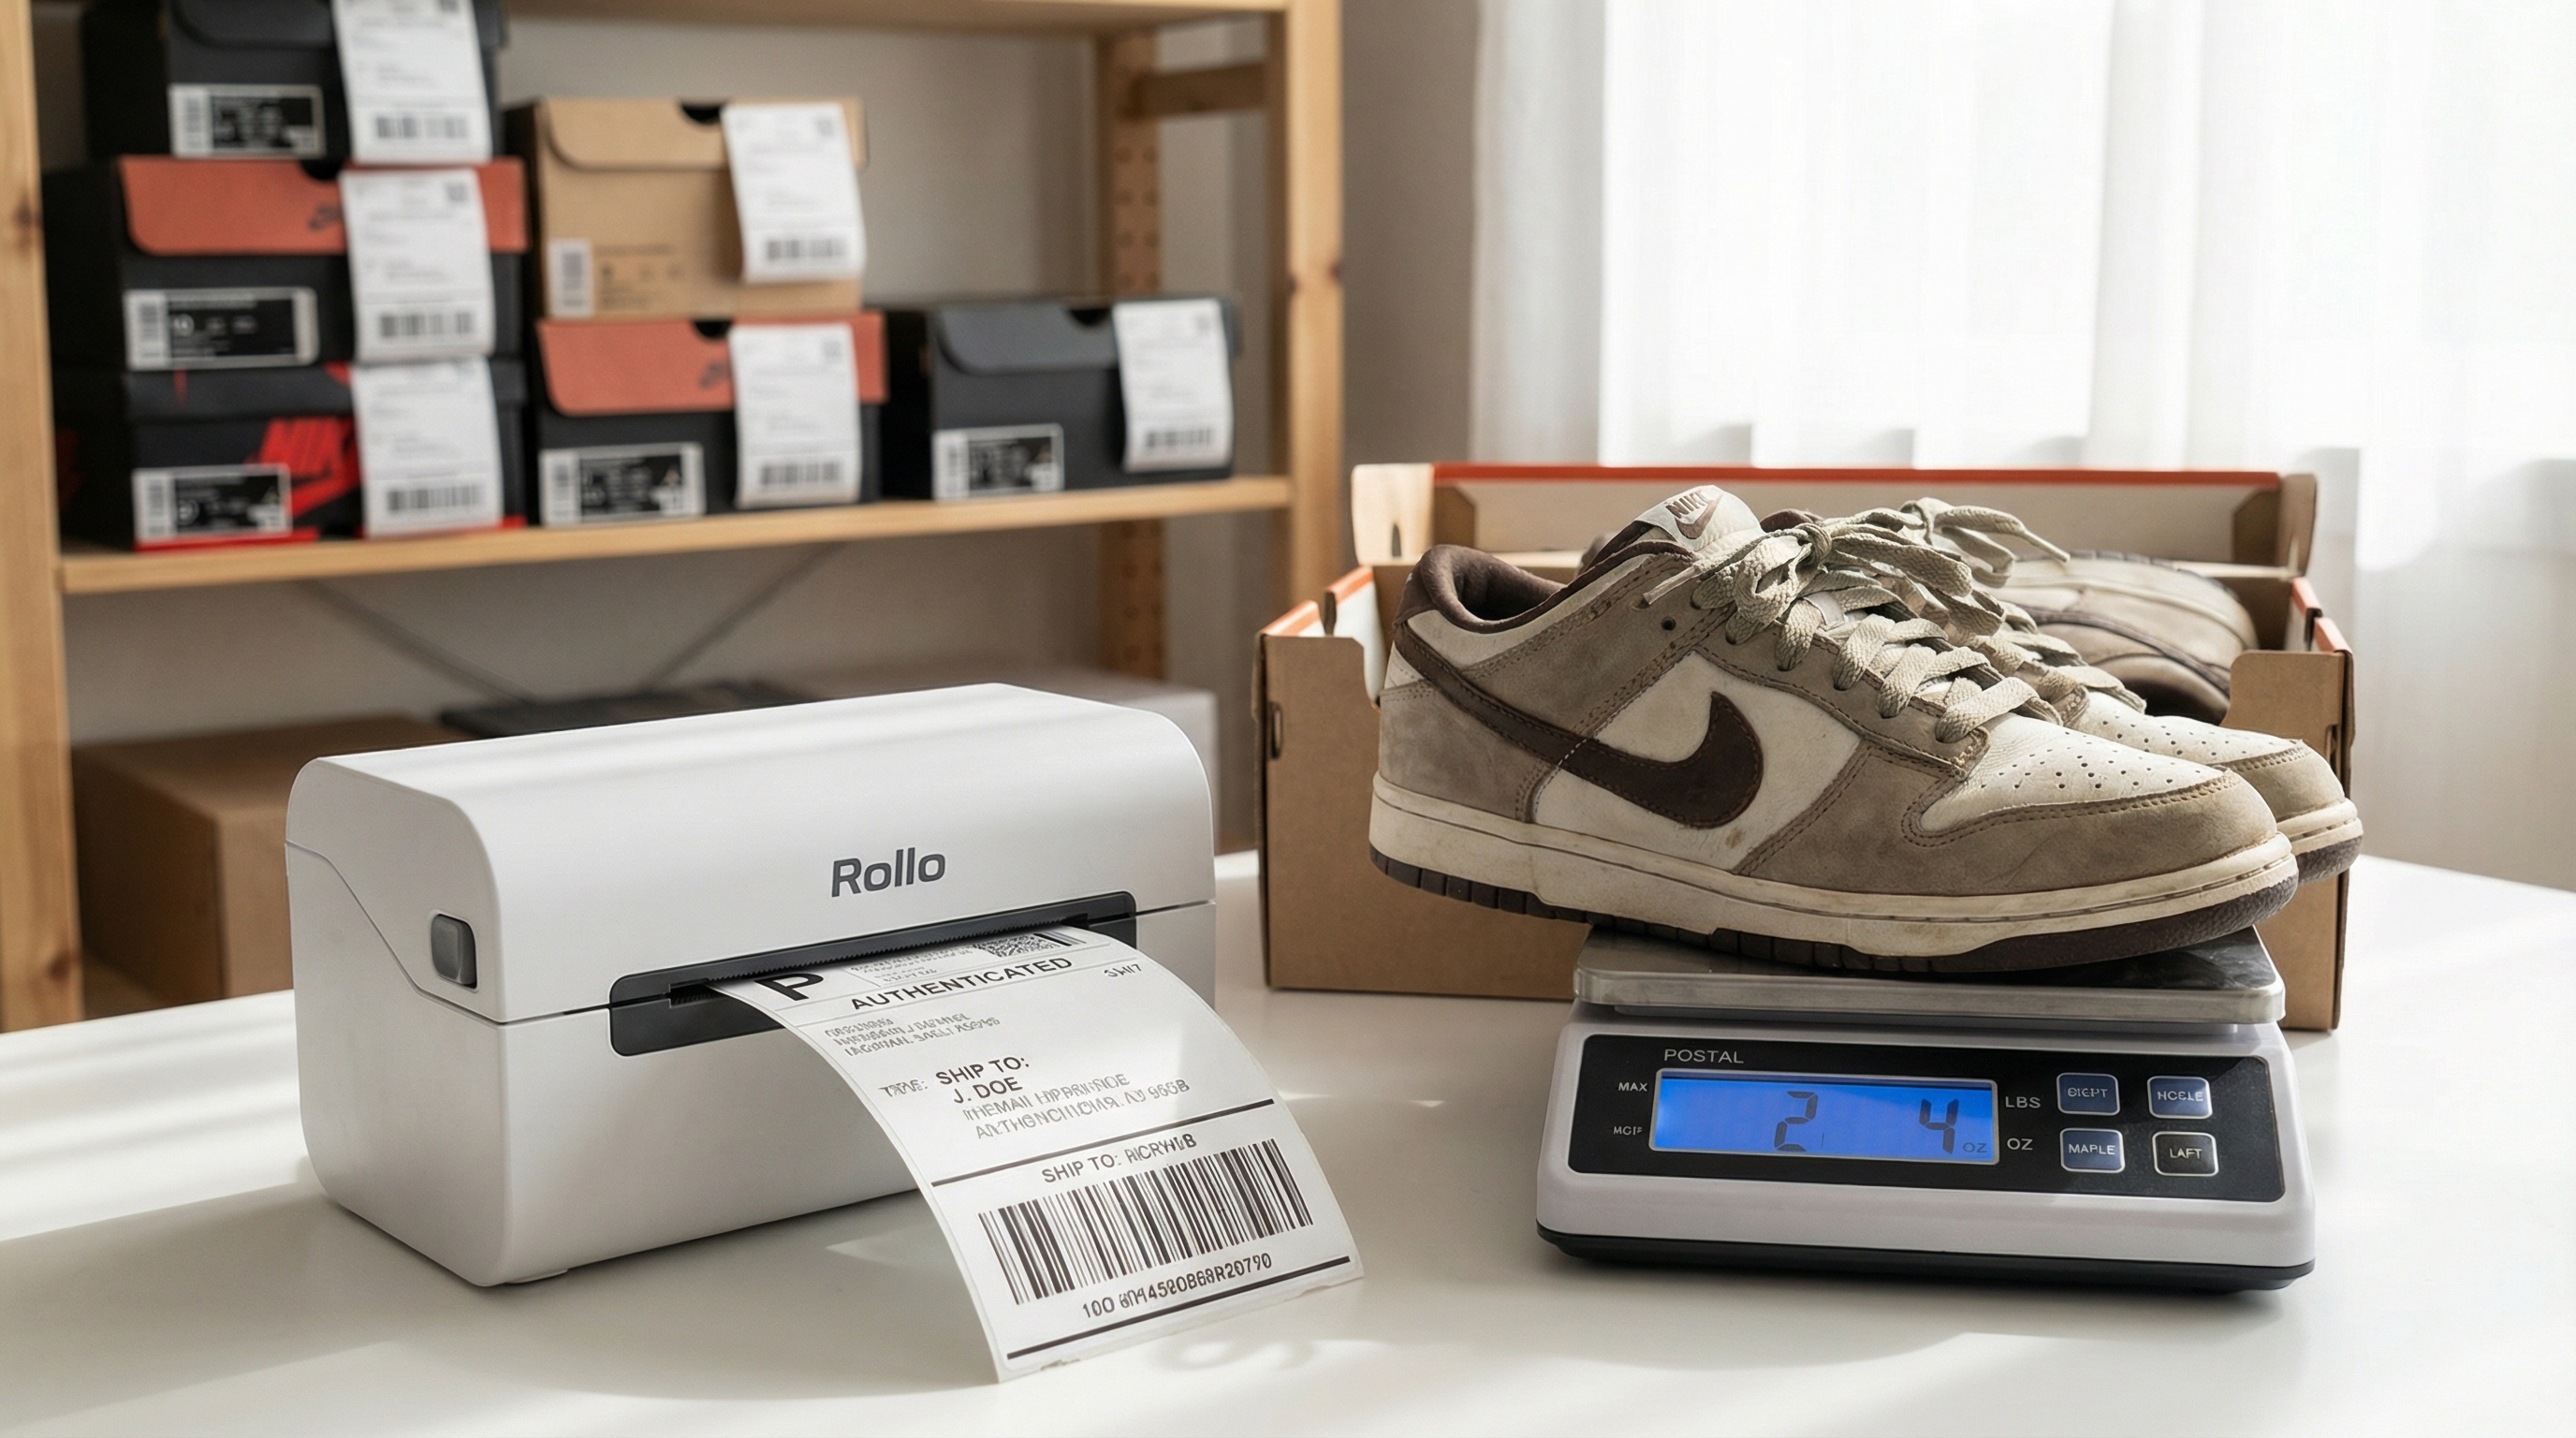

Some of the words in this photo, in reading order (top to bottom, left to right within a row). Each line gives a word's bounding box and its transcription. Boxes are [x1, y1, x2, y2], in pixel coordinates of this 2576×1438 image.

[831, 847, 945, 897] Rollo
[754, 971, 825, 1002] P
[851, 957, 1073, 1009] AUTHENTICATED
[1663, 1049, 1745, 1064] POSTAL
[935, 1064, 985, 1085] SHIP
[988, 1056, 1030, 1074] TO:
[973, 1077, 1023, 1099] DOE
[1617, 1081, 1648, 1093] MAX
[2005, 1095, 2042, 1109] LBS
[1774, 1091, 1819, 1152] 2
[1920, 1098, 1959, 1155] 4
[2006, 1137, 2034, 1151] OZ
[2068, 1143, 2116, 1155] MAPLE
[2169, 1148, 2203, 1160] LAFT
[1041, 1161, 1084, 1183] SHIP
[1087, 1153, 1122, 1171] TO:
